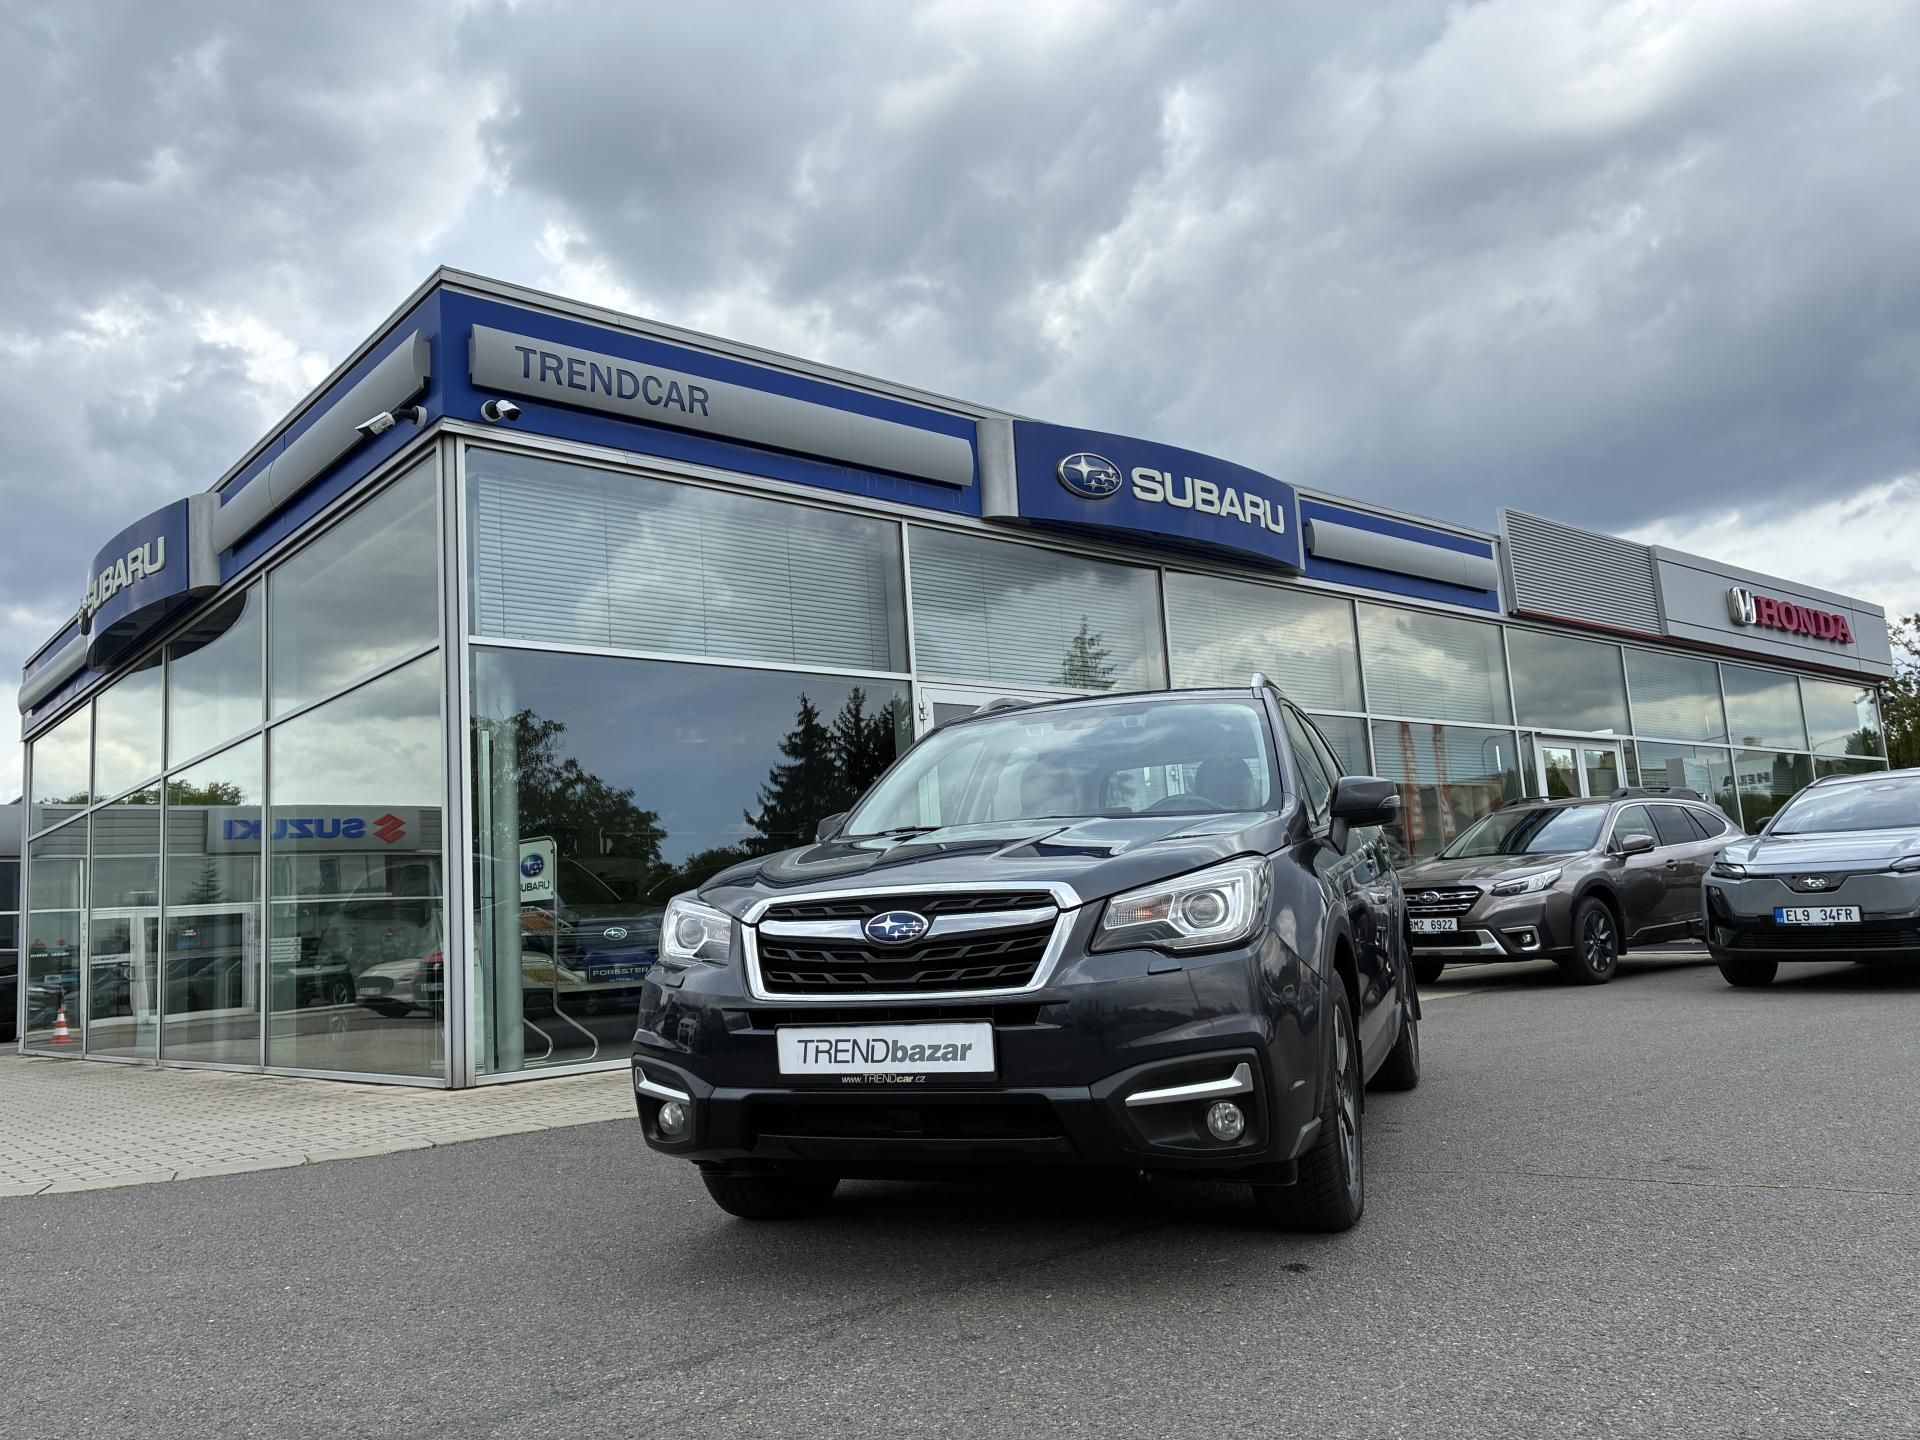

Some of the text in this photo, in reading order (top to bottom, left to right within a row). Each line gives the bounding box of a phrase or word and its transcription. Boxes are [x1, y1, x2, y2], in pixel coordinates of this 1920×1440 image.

[515, 346, 709, 416] TRENDCAR
[1131, 467, 1285, 534] SUBARU
[87, 536, 165, 618] SUBARU
[1754, 595, 1854, 644] HONDA
[520, 880, 550, 893] UBARU
[1431, 919, 1453, 930] 6922
[1786, 909, 1810, 922] EL9
[1820, 908, 1853, 921] 34FR
[797, 1038, 972, 1064] TRENDbazar
[842, 1073, 926, 1084] www.TRENDcar.cz
